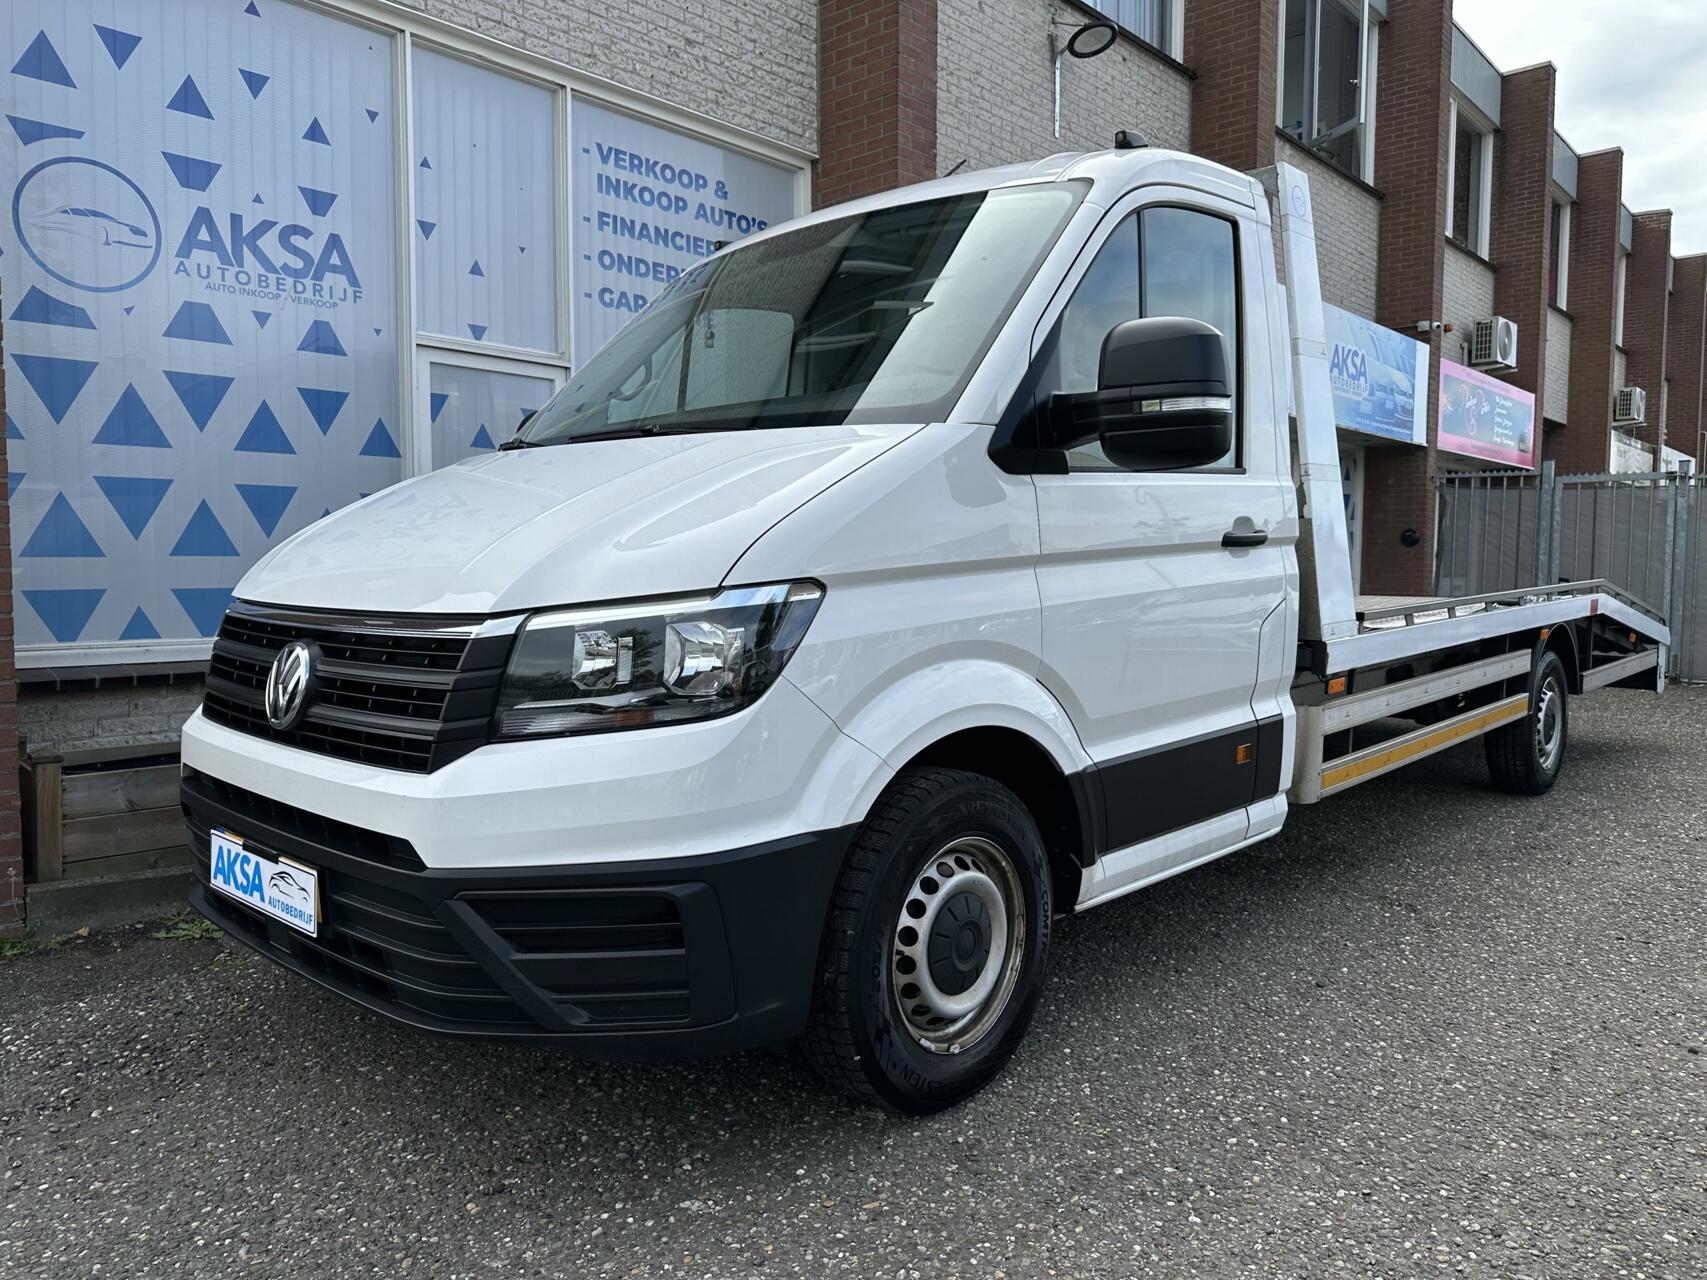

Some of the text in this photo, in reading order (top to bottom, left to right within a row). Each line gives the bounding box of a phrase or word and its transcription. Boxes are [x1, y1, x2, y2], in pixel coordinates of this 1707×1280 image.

[595, 142, 708, 193] VERKOOP
[714, 180, 729, 200] &
[596, 173, 768, 234] INKOOP AUTO'S
[174, 205, 362, 289] AKSA
[597, 249, 686, 284] ONDER
[174, 260, 363, 304] AUTOBEDRIJF
[205, 281, 338, 310] AUTO INKOOP VERKOOP
[1330, 343, 1368, 385] AKSA
[213, 844, 266, 904] AKSA
[268, 895, 314, 926] AUTOBEDRIJF
